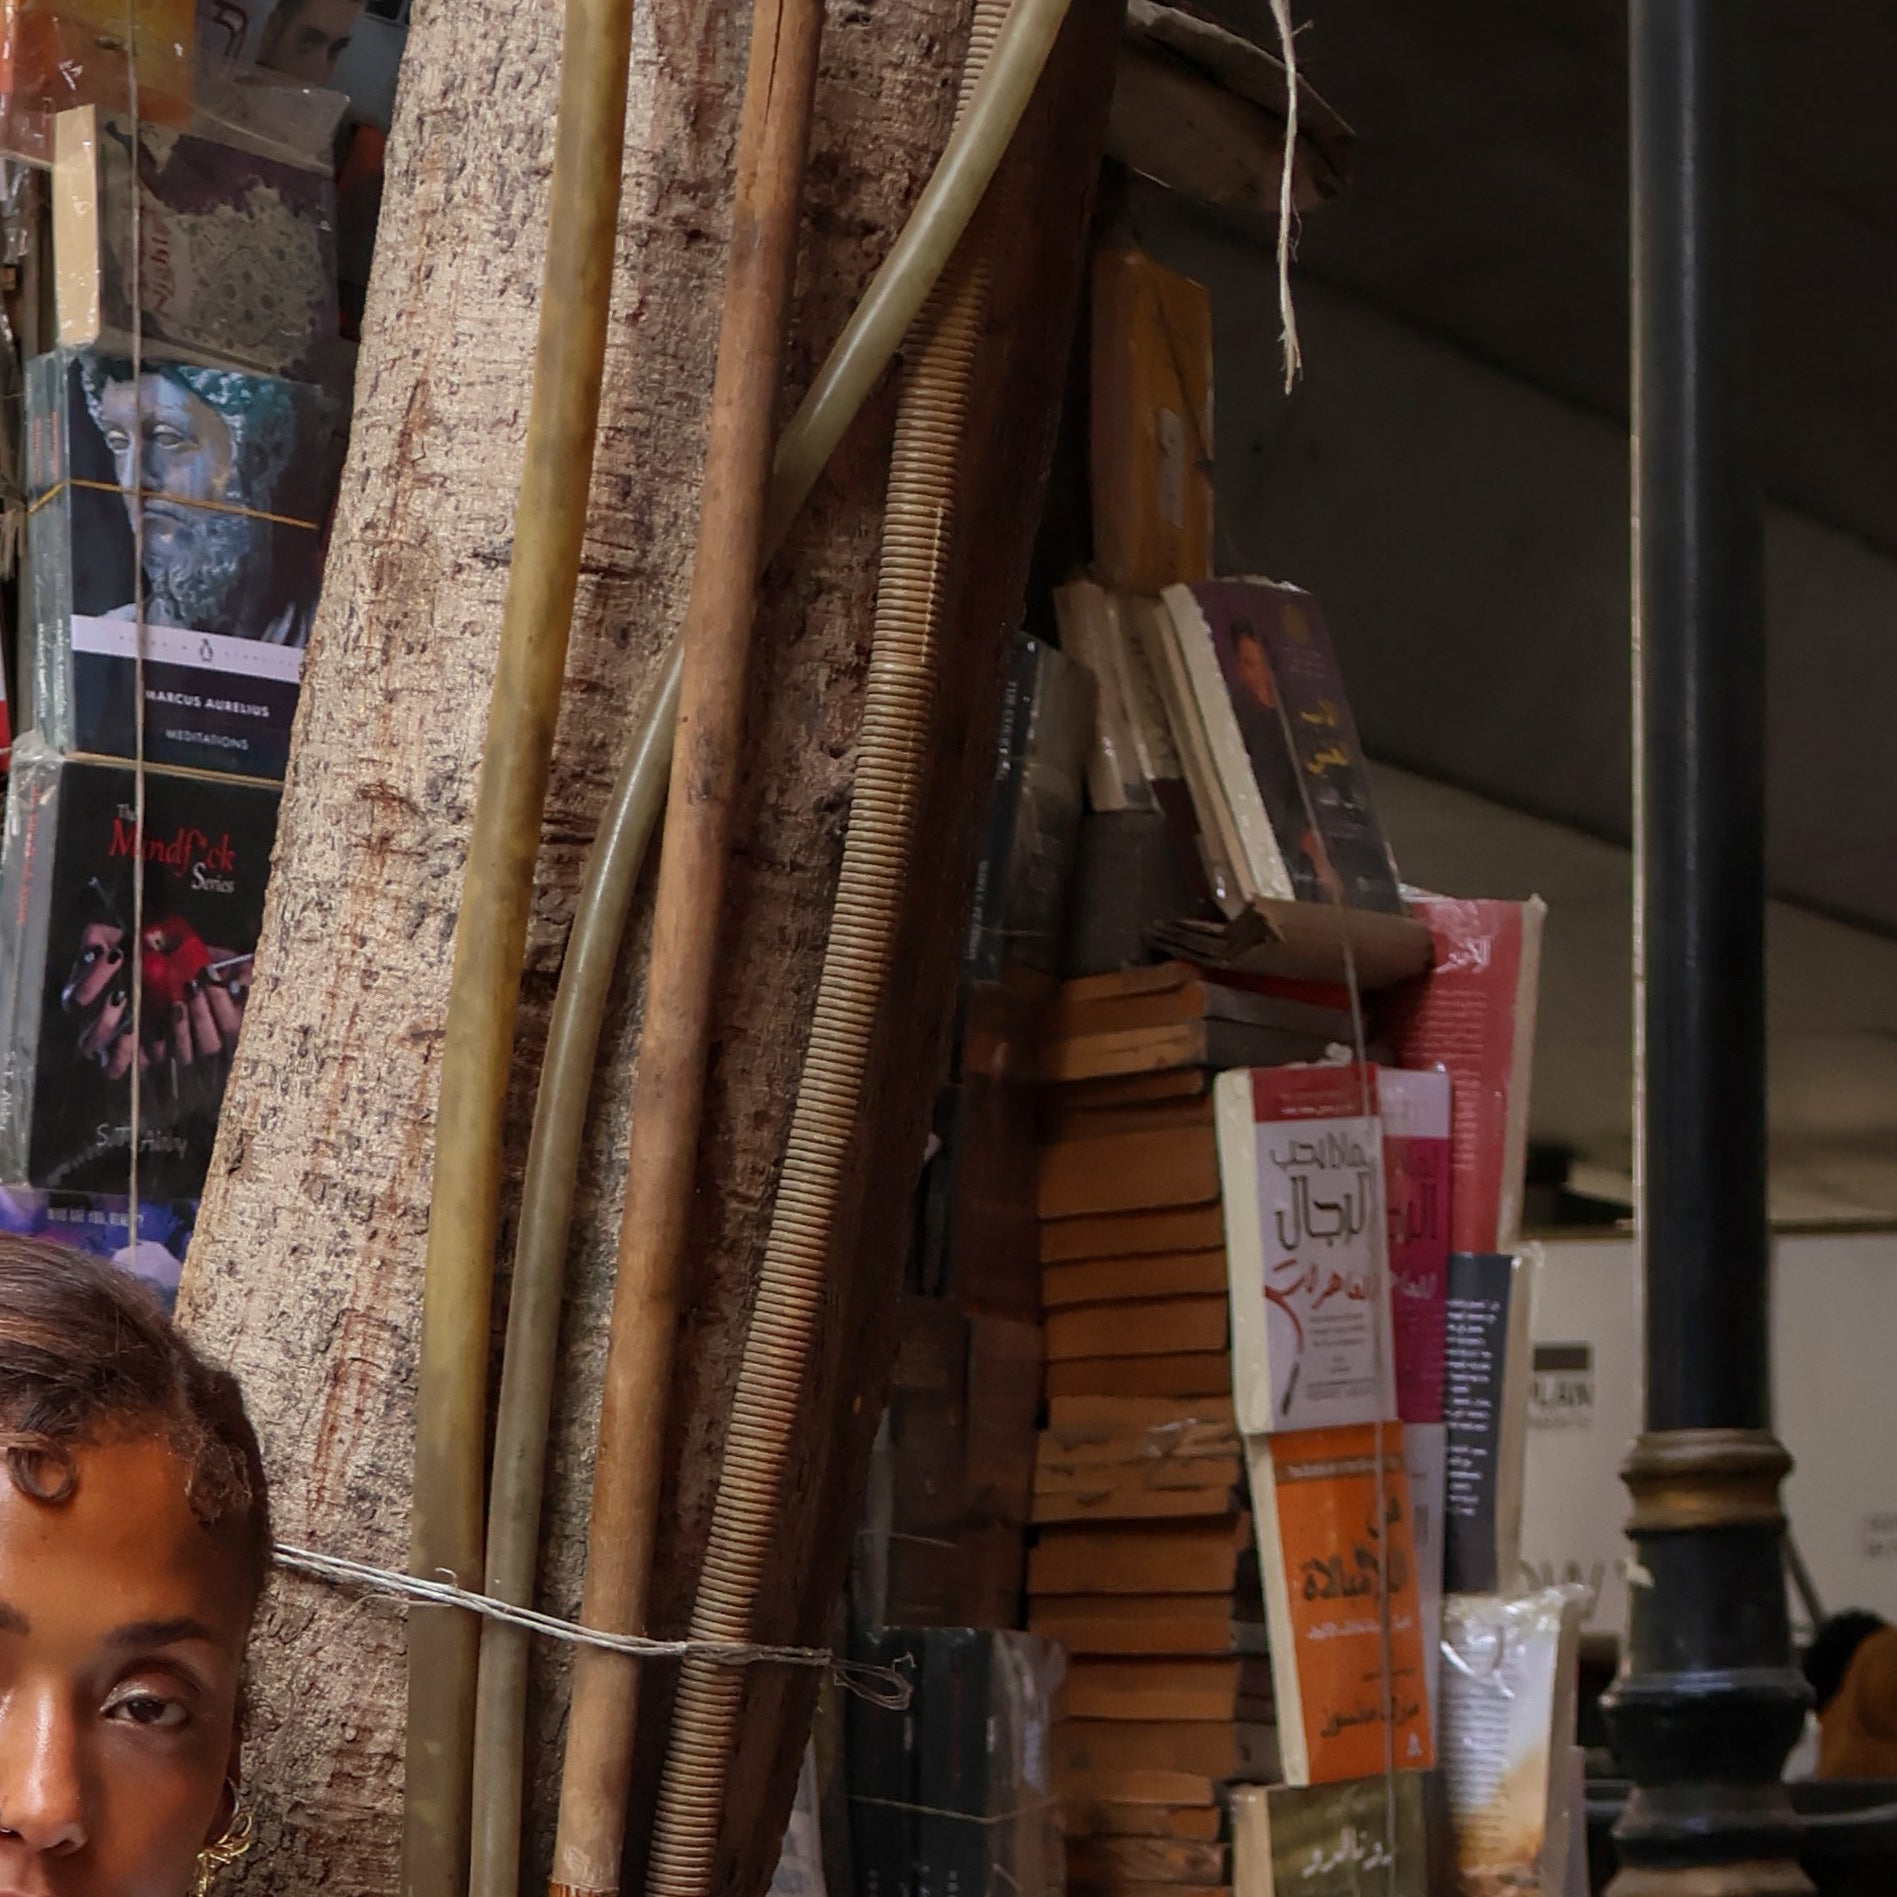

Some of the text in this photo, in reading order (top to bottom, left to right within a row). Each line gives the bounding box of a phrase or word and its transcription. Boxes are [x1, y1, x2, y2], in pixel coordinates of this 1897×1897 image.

[145, 686, 271, 719] MARCUS AURELIUS
[165, 727, 250, 753] MEDITATIONS
[190, 862, 236, 895] Series
